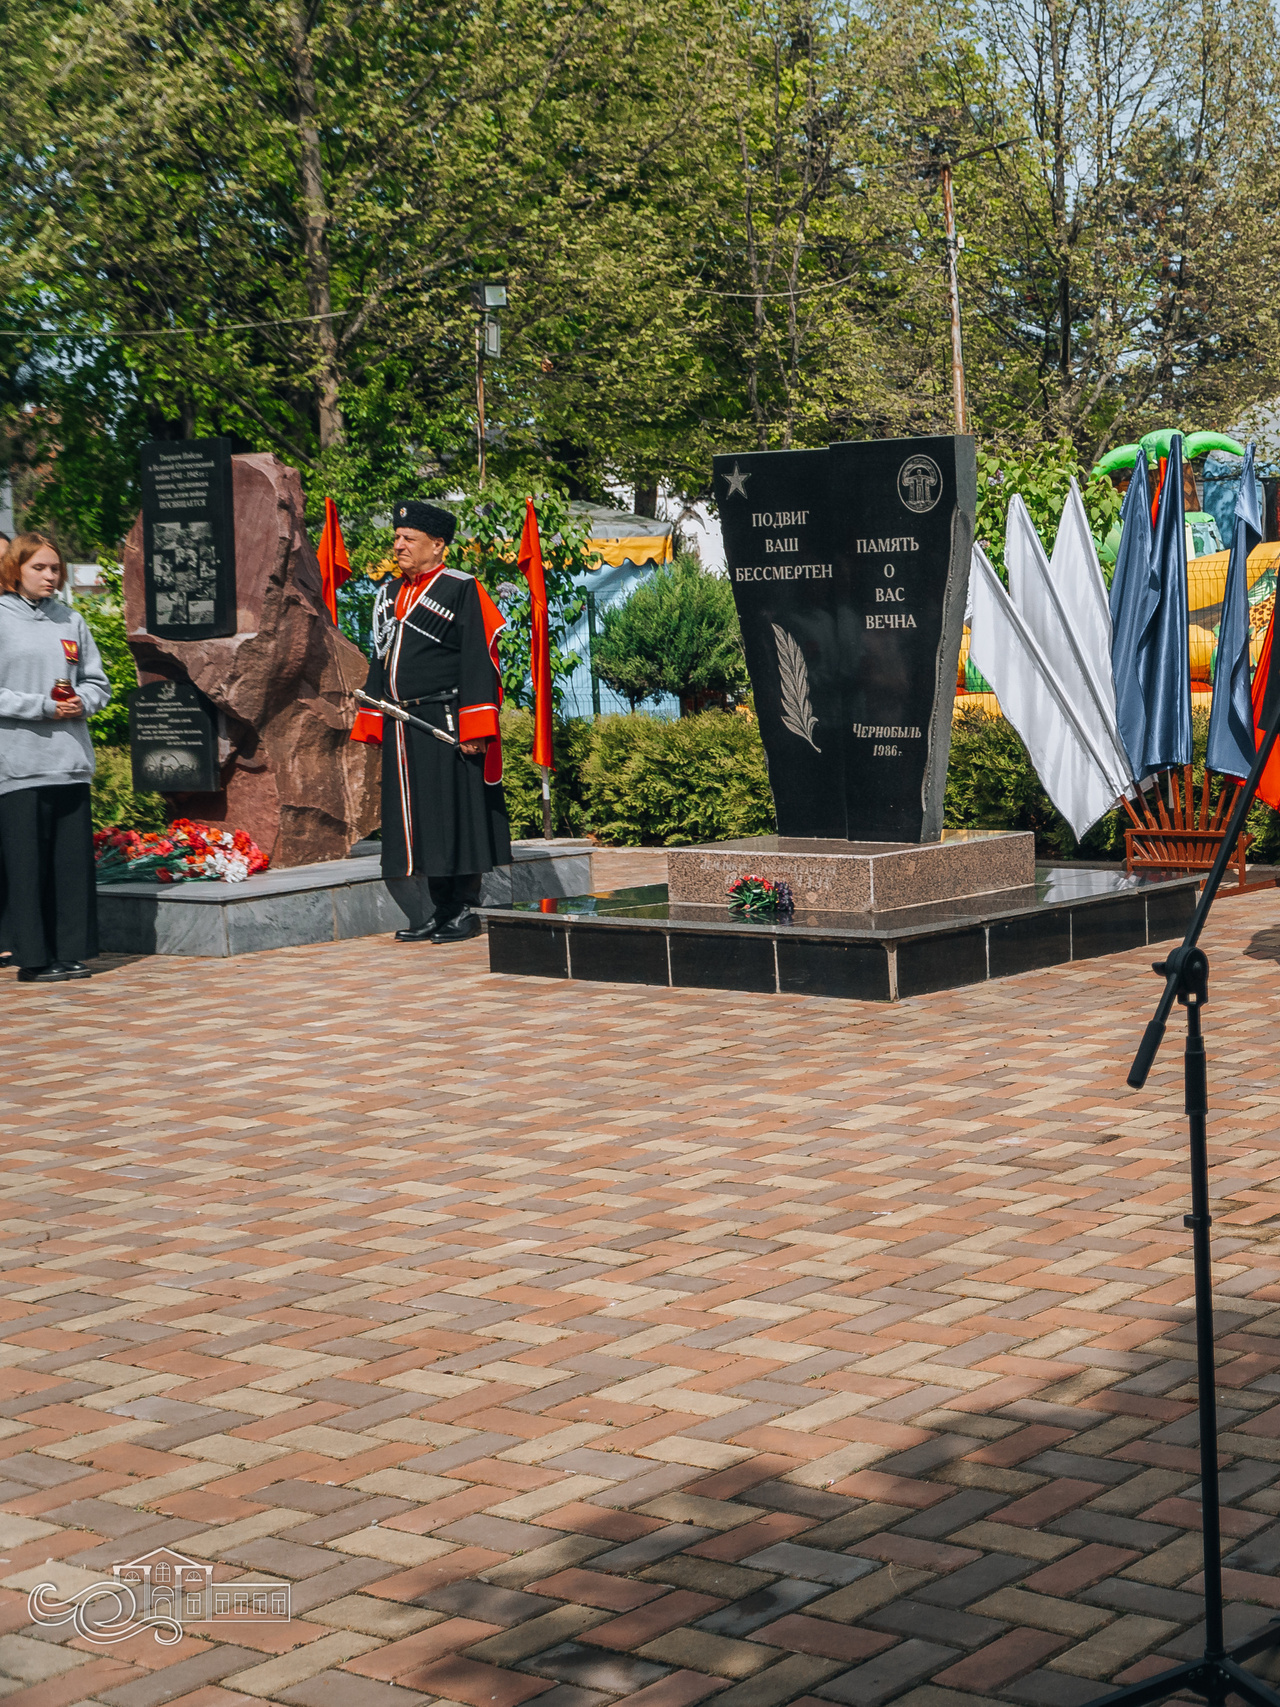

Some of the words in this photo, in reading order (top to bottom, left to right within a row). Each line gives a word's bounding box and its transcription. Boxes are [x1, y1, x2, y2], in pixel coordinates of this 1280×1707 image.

[751, 510, 810, 529] ПОДВИГ
[765, 538, 799, 553] ВАШ
[856, 536, 920, 553] ПАМЯТЬ
[735, 563, 834, 582] БЕССМЕРТЕН
[883, 563, 895, 579] О
[875, 587, 905, 602] ВАС
[865, 614, 917, 629] ВЕЧНА
